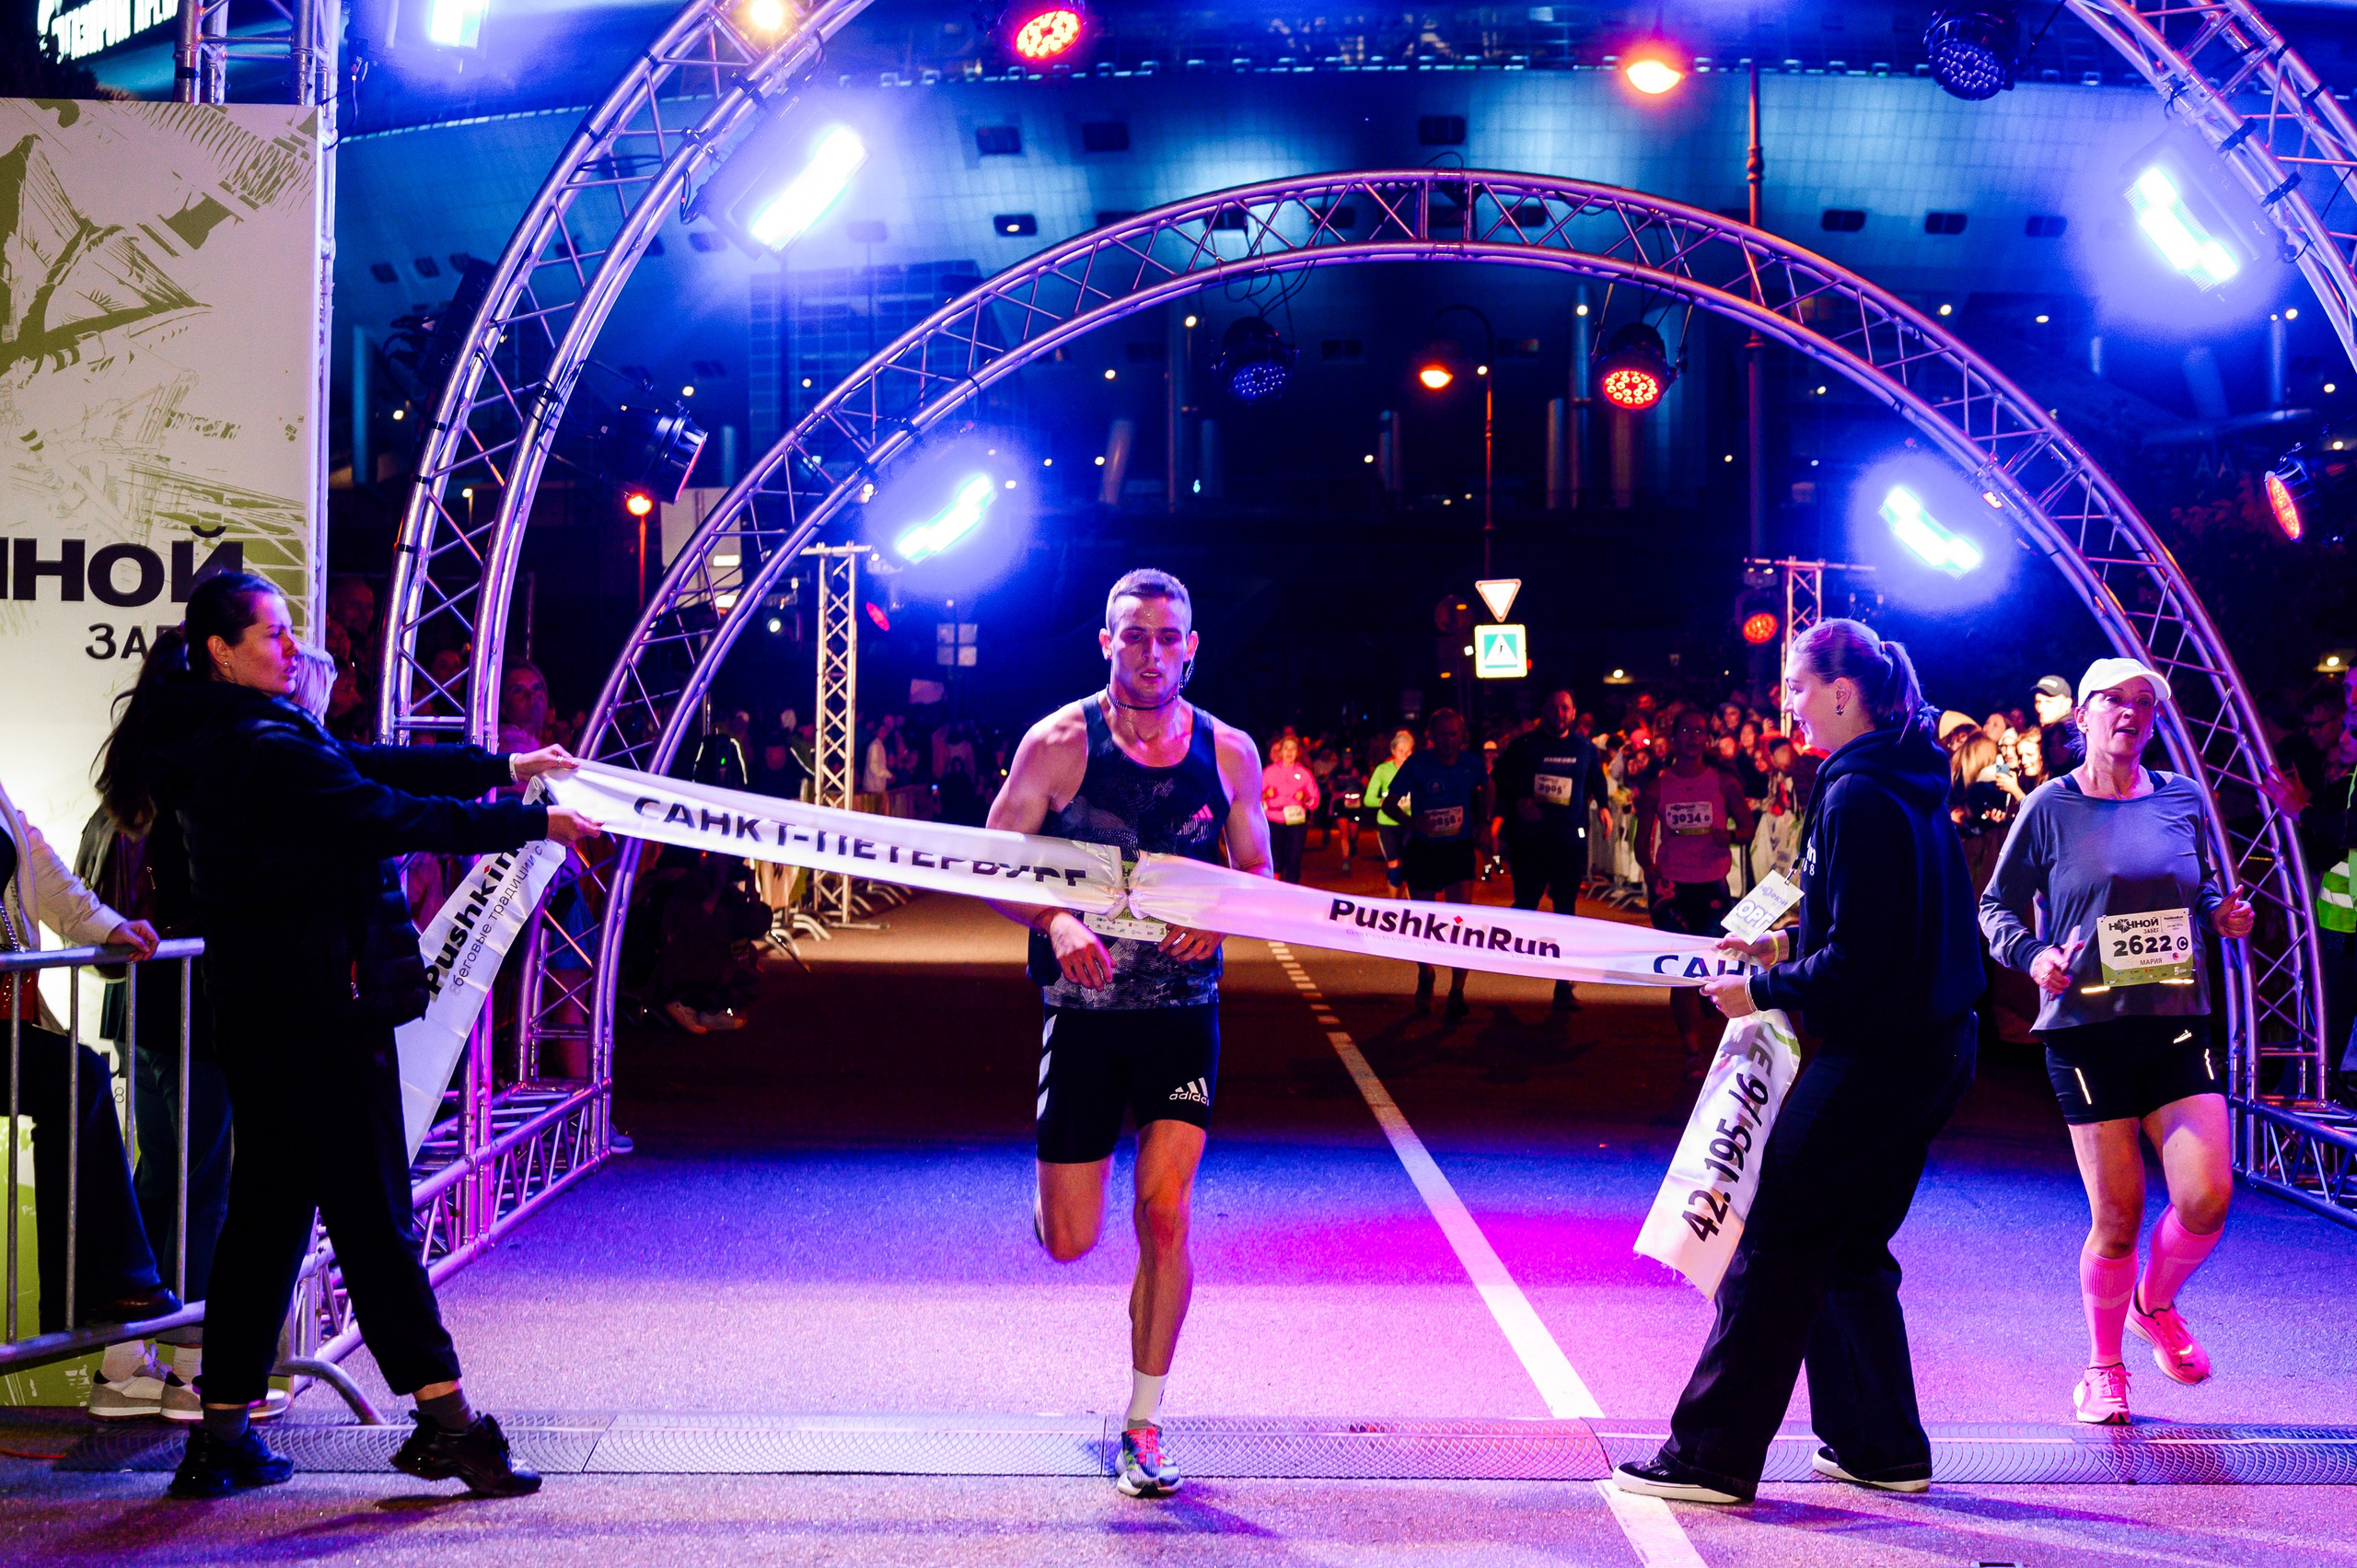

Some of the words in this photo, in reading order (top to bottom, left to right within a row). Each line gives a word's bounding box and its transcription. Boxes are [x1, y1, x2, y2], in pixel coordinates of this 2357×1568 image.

[452, 922, 493, 987] беговые
[487, 854, 536, 922] традиции
[1329, 898, 1561, 958] PushkinRun
[1736, 899, 1776, 929] ОРГ
[2113, 935, 2173, 958] 2622
[2140, 958, 2163, 966] МАРИЯ
